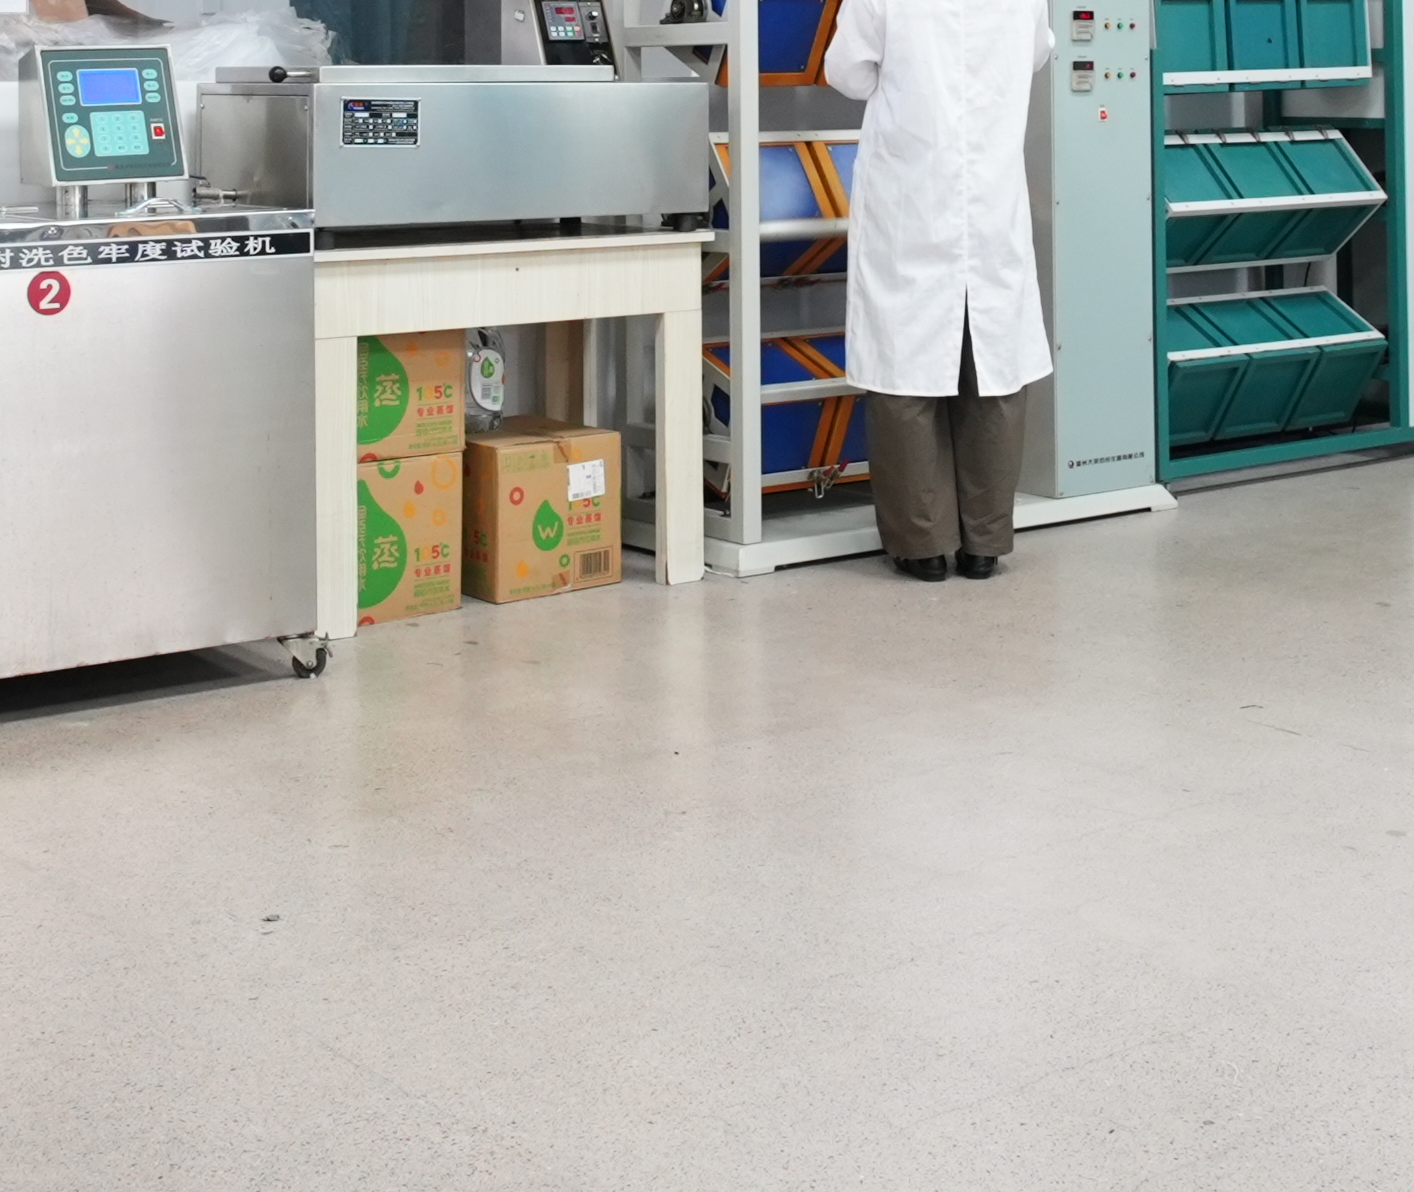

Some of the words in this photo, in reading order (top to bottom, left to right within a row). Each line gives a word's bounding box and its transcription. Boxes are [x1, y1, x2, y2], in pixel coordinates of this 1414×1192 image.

[38, 278, 61, 310] 2
[374, 374, 401, 407] 蒸
[417, 405, 454, 417] 专业蒸馏
[567, 512, 601, 526] 专业蒸馏
[538, 521, 558, 540] W
[372, 534, 400, 570] 蒸
[414, 564, 451, 577] 专业蒸馏
